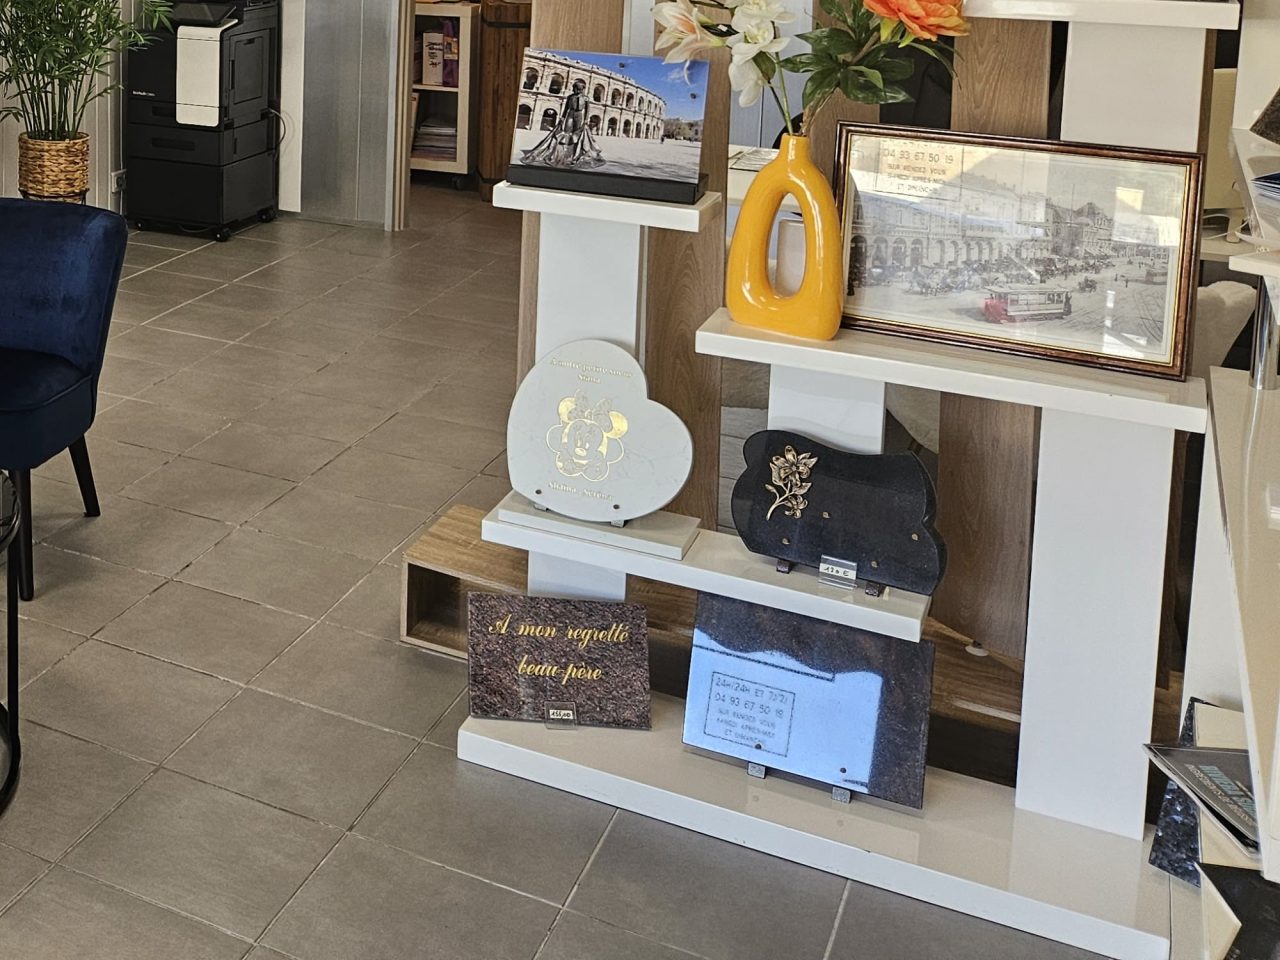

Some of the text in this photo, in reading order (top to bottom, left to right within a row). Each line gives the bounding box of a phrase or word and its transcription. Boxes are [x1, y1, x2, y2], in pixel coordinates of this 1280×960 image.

[928, 153, 940, 163] 50
[489, 614, 629, 649] A mon regretté
[517, 655, 602, 685] beau-père
[730, 696, 740, 707] 93
[744, 700, 756, 711] 67
